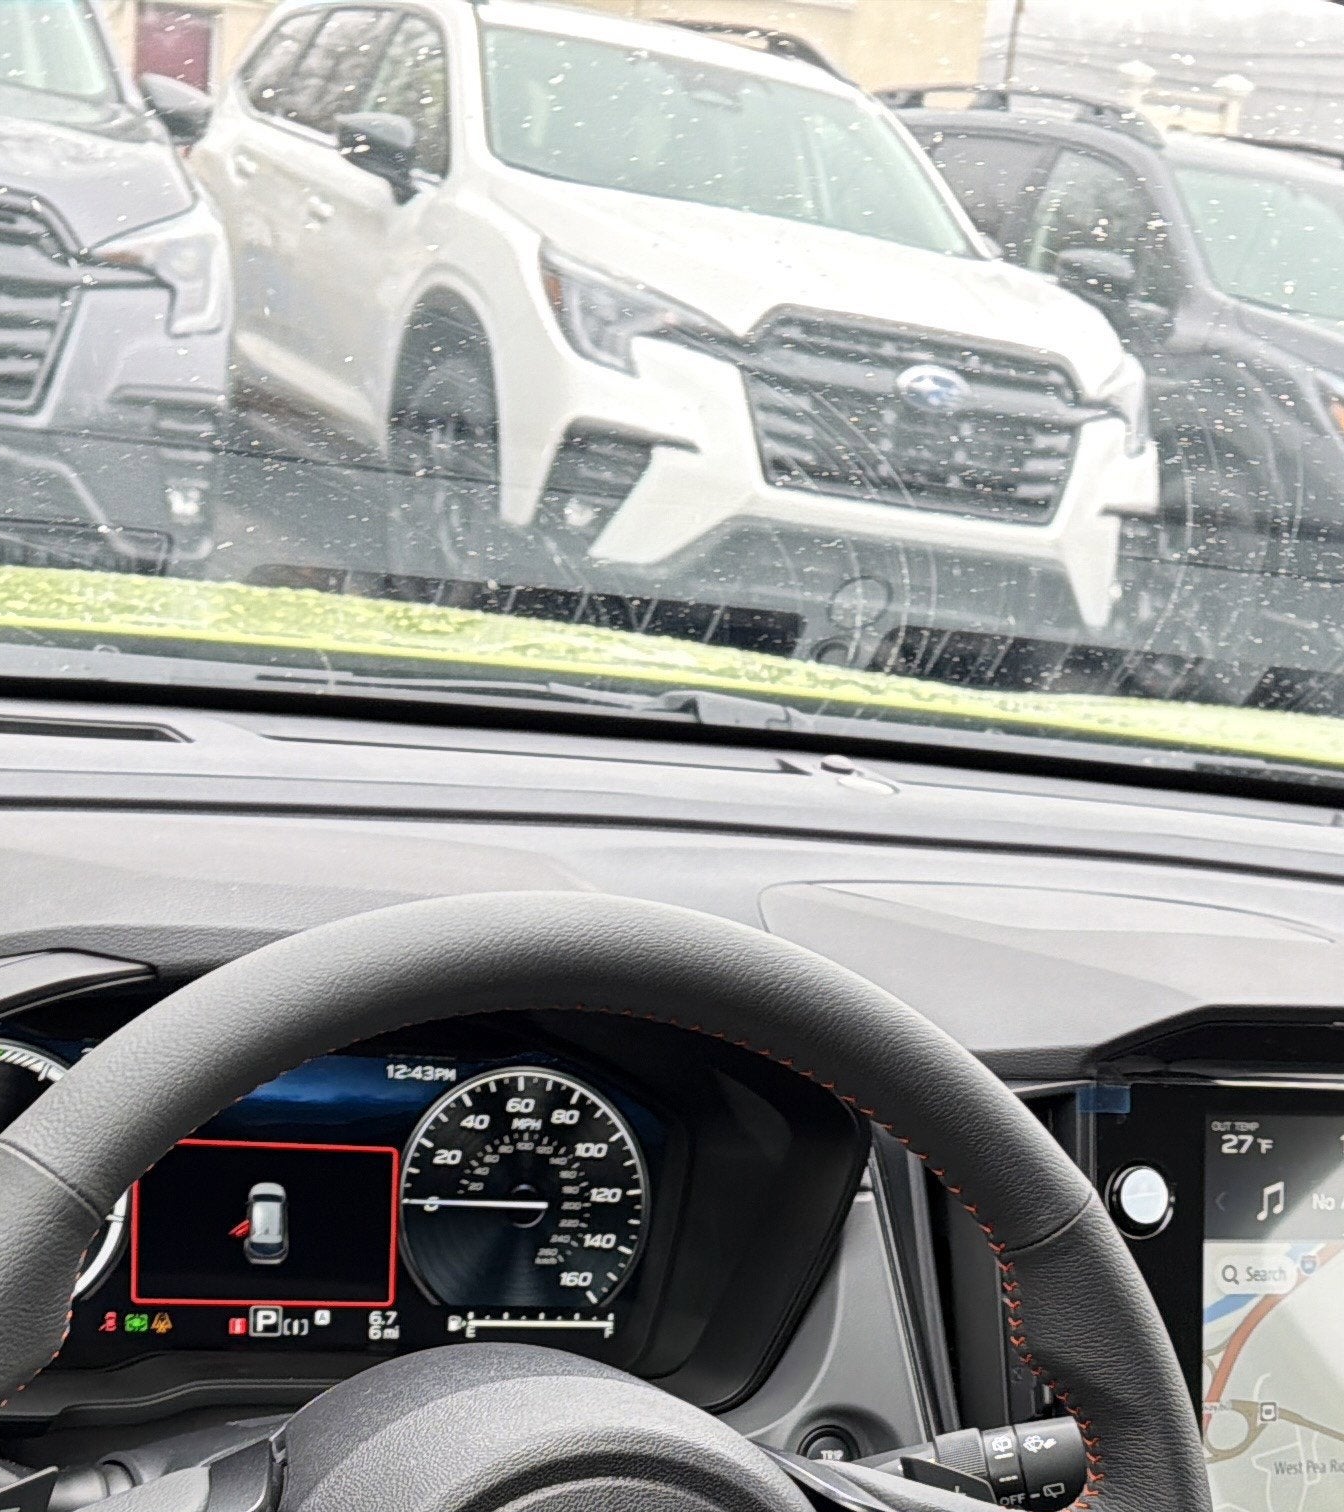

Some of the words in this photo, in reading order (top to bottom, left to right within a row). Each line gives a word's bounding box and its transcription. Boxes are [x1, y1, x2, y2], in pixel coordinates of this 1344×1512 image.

[506, 1097, 536, 1113] 60
[460, 1114, 490, 1130] 40
[511, 1117, 542, 1131] MPH
[550, 1109, 580, 1125] 80
[574, 1143, 608, 1158] 100
[1221, 1134, 1254, 1154] 27
[433, 1149, 462, 1165] 20
[590, 1188, 622, 1203] 120
[1312, 1193, 1336, 1211] No
[583, 1233, 616, 1249] 140
[559, 1271, 593, 1287] 160
[1245, 1265, 1288, 1283] Search
[256, 1311, 277, 1332] P
[368, 1310, 398, 1326] 6.7
[1273, 1461, 1302, 1476] West
[1306, 1460, 1326, 1475] Pea
[1000, 1493, 1026, 1506] OFF
